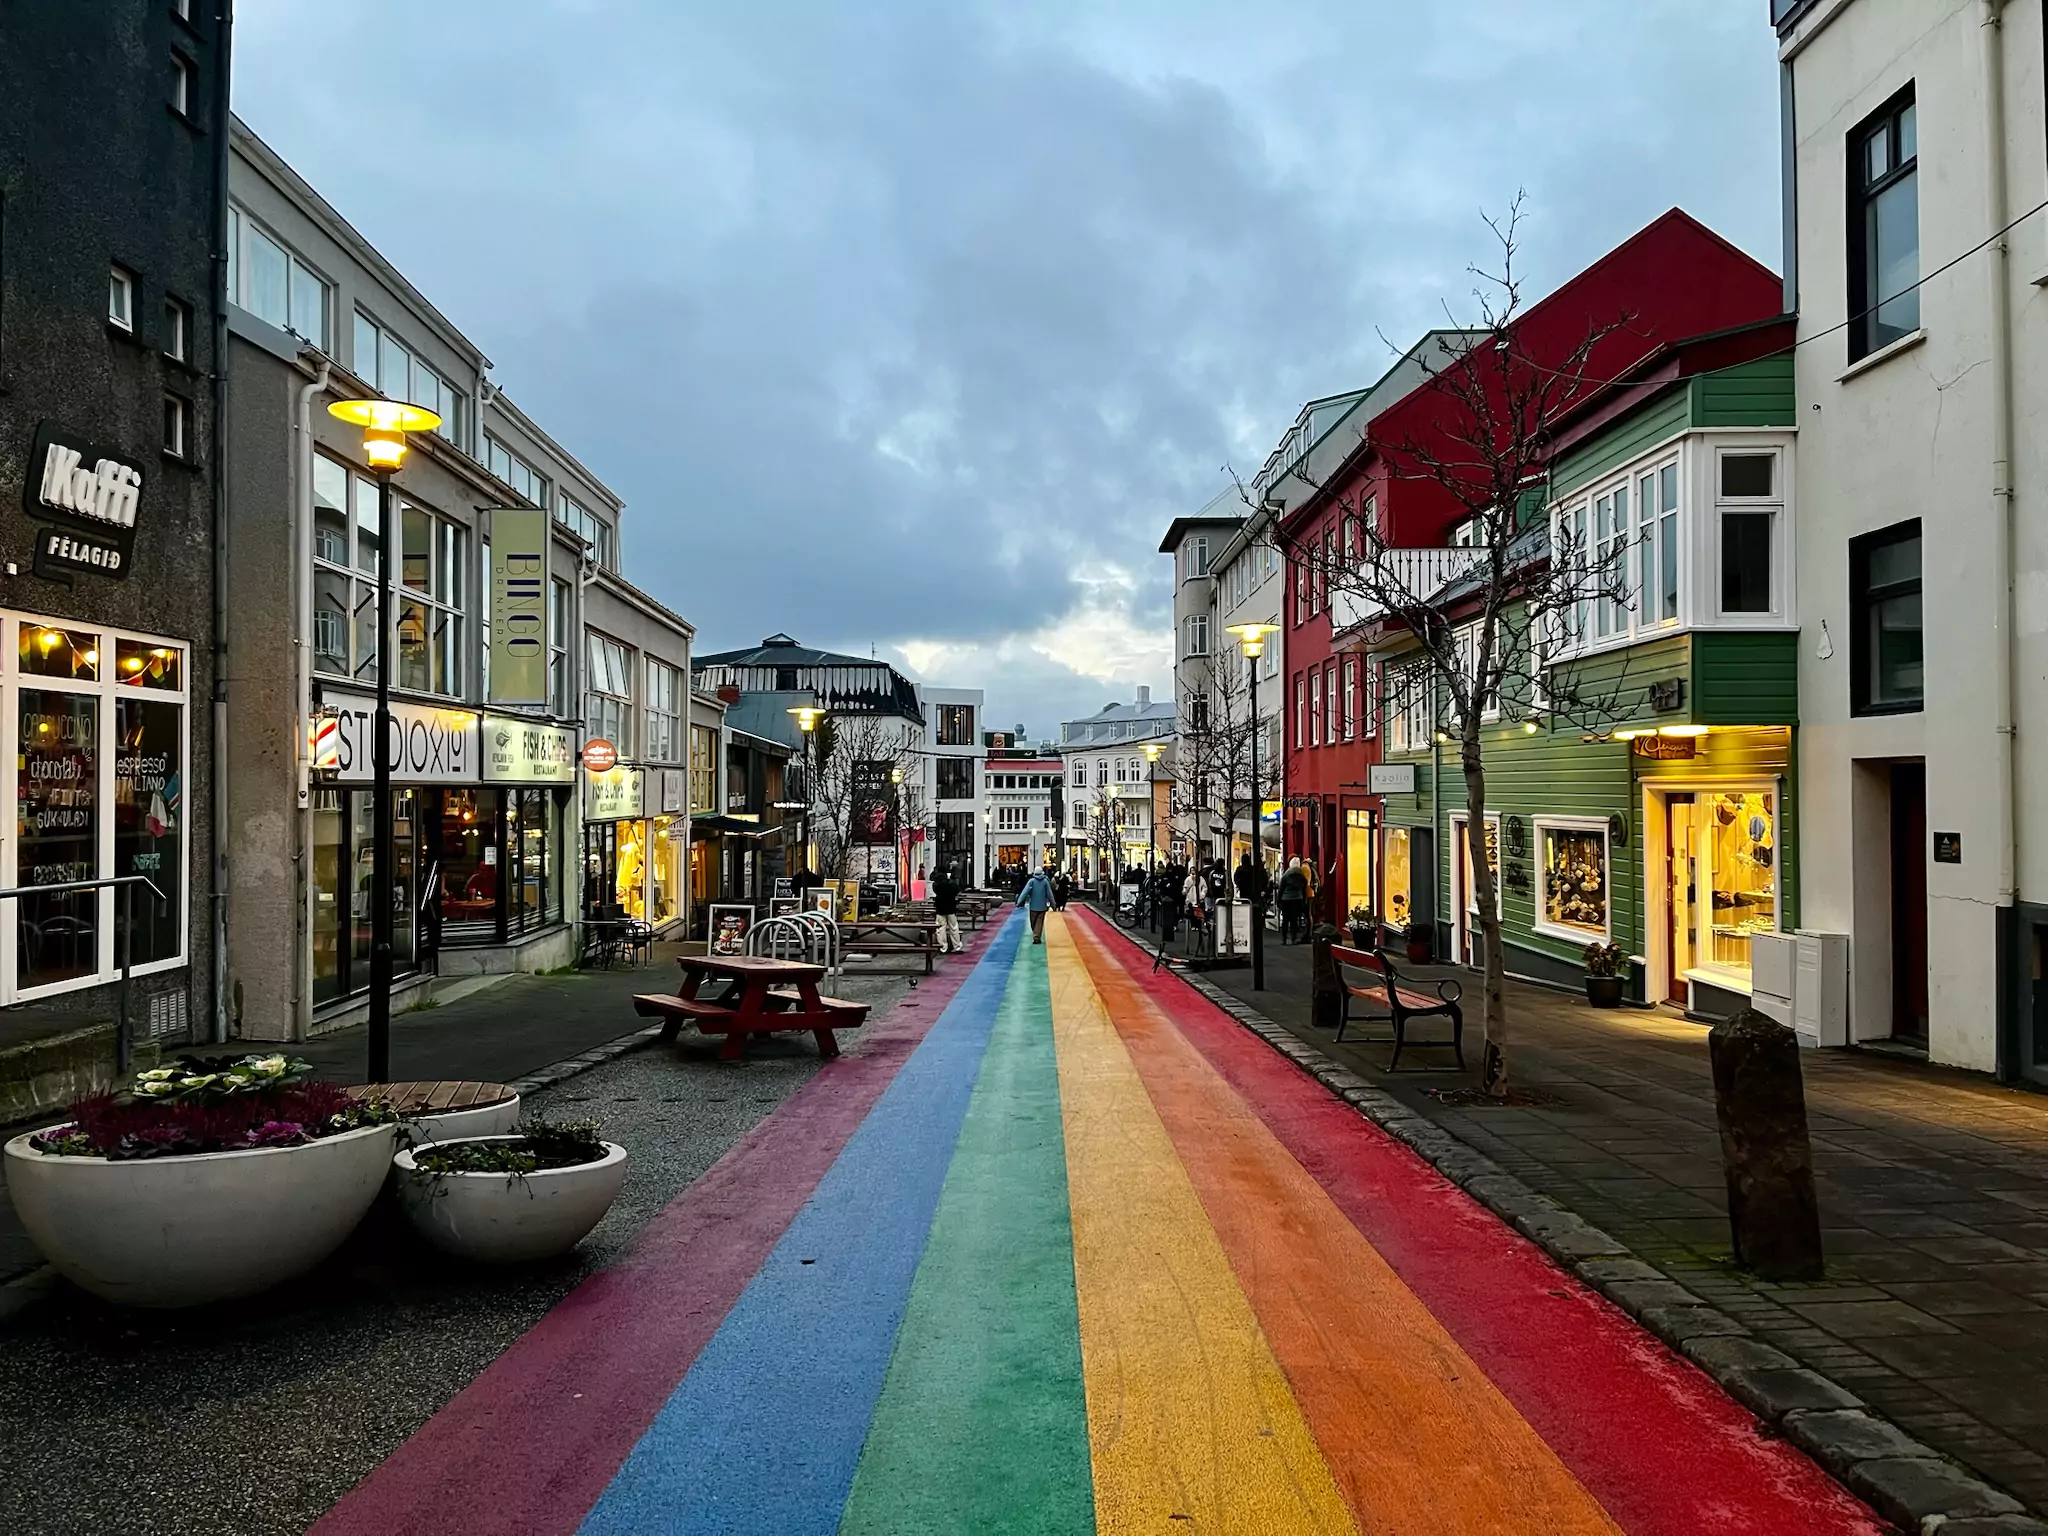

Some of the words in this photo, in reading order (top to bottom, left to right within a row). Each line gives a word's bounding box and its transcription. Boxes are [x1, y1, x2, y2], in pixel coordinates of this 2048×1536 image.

[41, 443, 141, 528] Kaffi
[47, 536, 121, 569] FÉLAGIÐ
[495, 566, 504, 646] DRINKERY
[506, 554, 541, 658] BINGO
[523, 731, 539, 760] FISH
[541, 735, 547, 760] &
